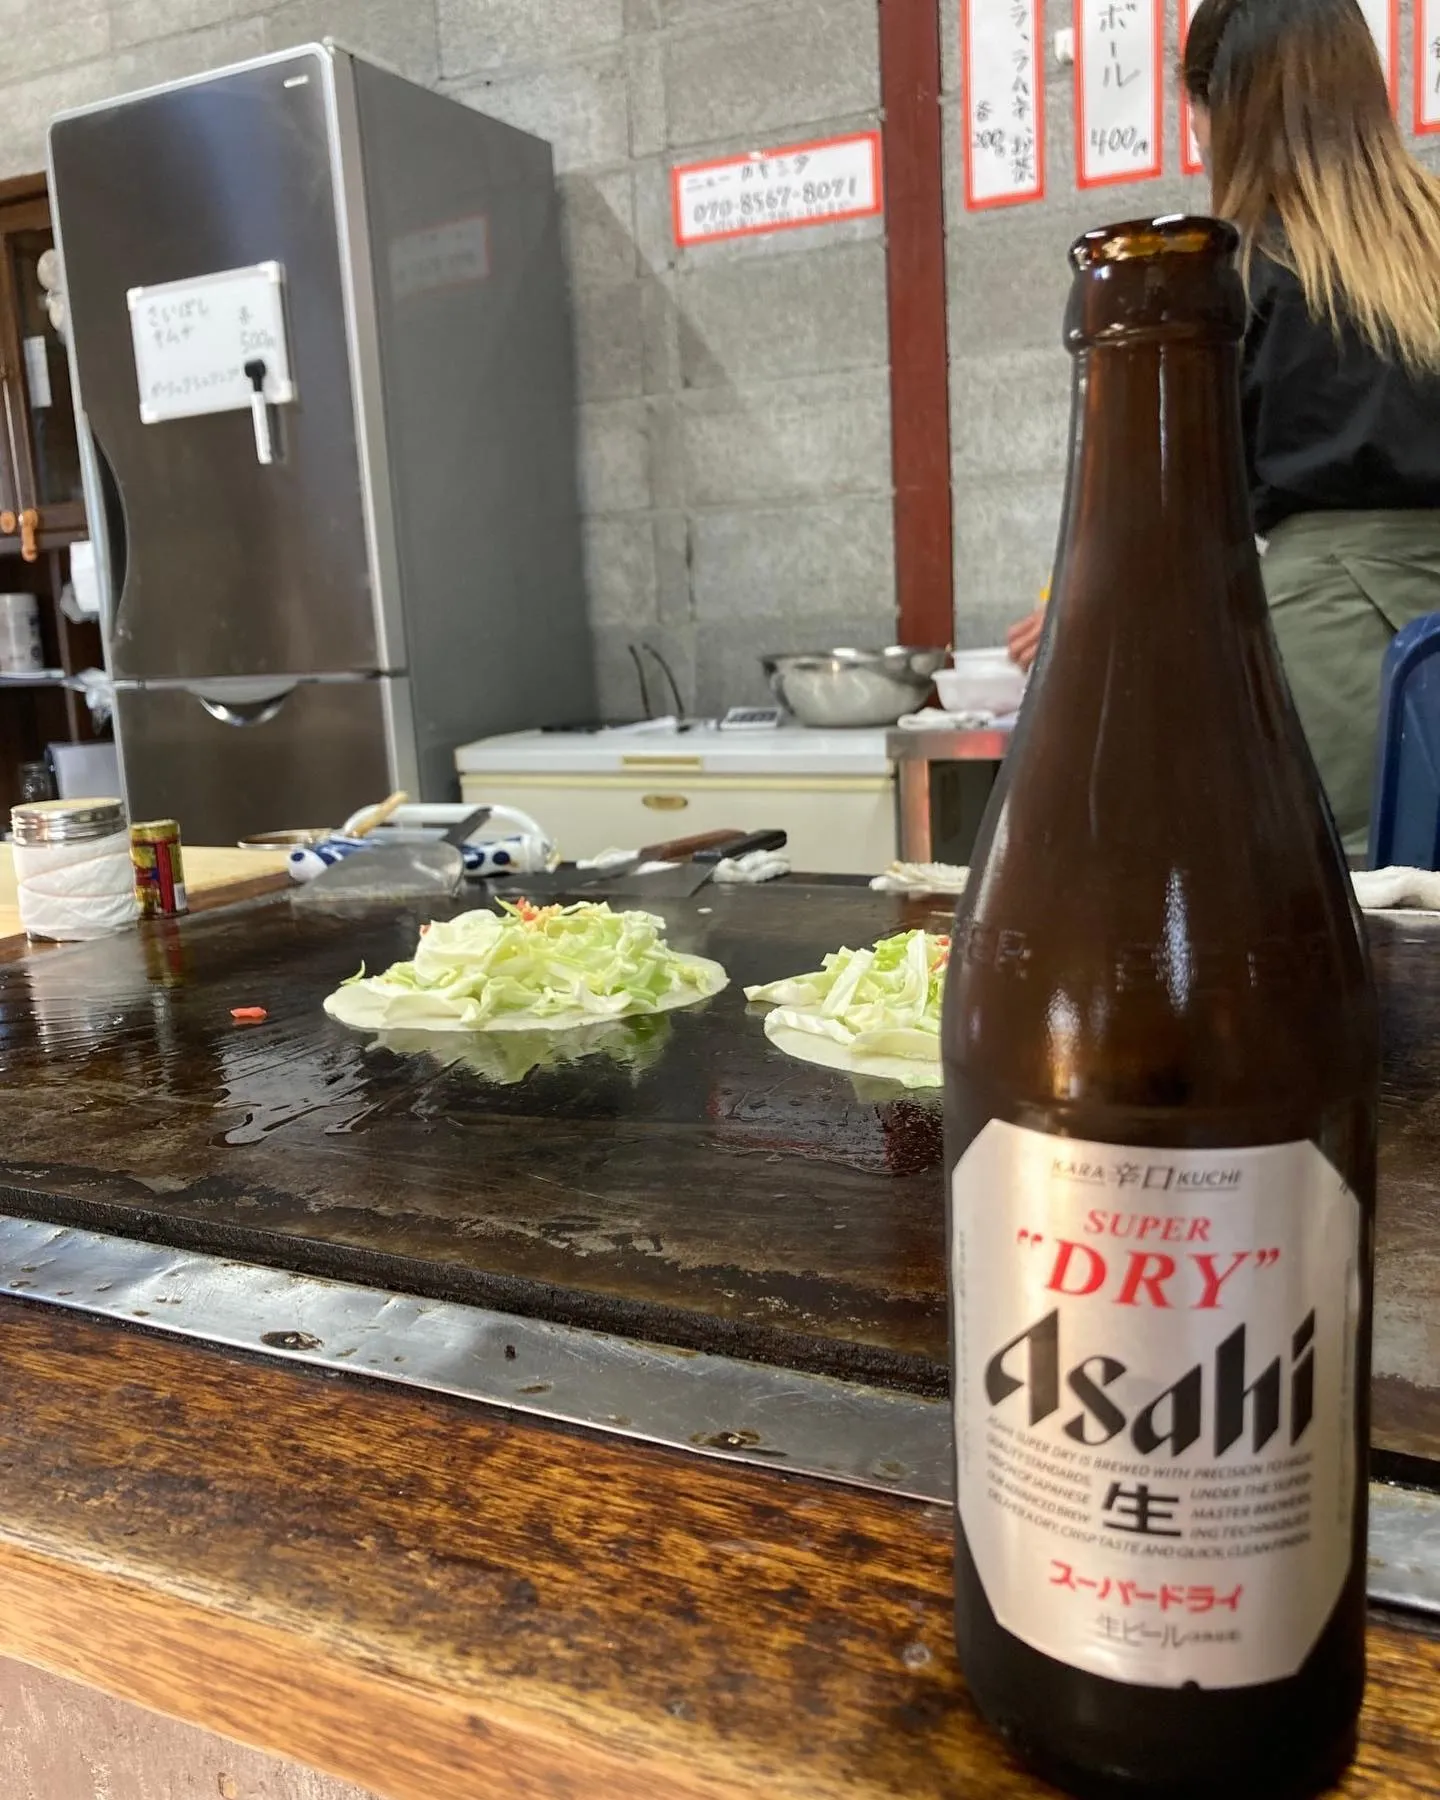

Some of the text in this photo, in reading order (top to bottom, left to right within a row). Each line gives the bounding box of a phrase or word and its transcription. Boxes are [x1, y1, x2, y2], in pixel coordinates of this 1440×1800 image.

[1115, 1162, 1174, 1190] 辛口
[1177, 1168, 1242, 1186] KUCHI
[1083, 1208, 1213, 1243] SUPER
[983, 1306, 1317, 1460] Asahi
[1051, 1445, 1078, 1464] DRY
[1093, 1456, 1151, 1477] BREWED
[1153, 1465, 1190, 1480] WITH
[1101, 1481, 1182, 1538] 生
[1049, 1558, 1245, 1613] スーパードライ
[1095, 1611, 1187, 1649] 生ビール
